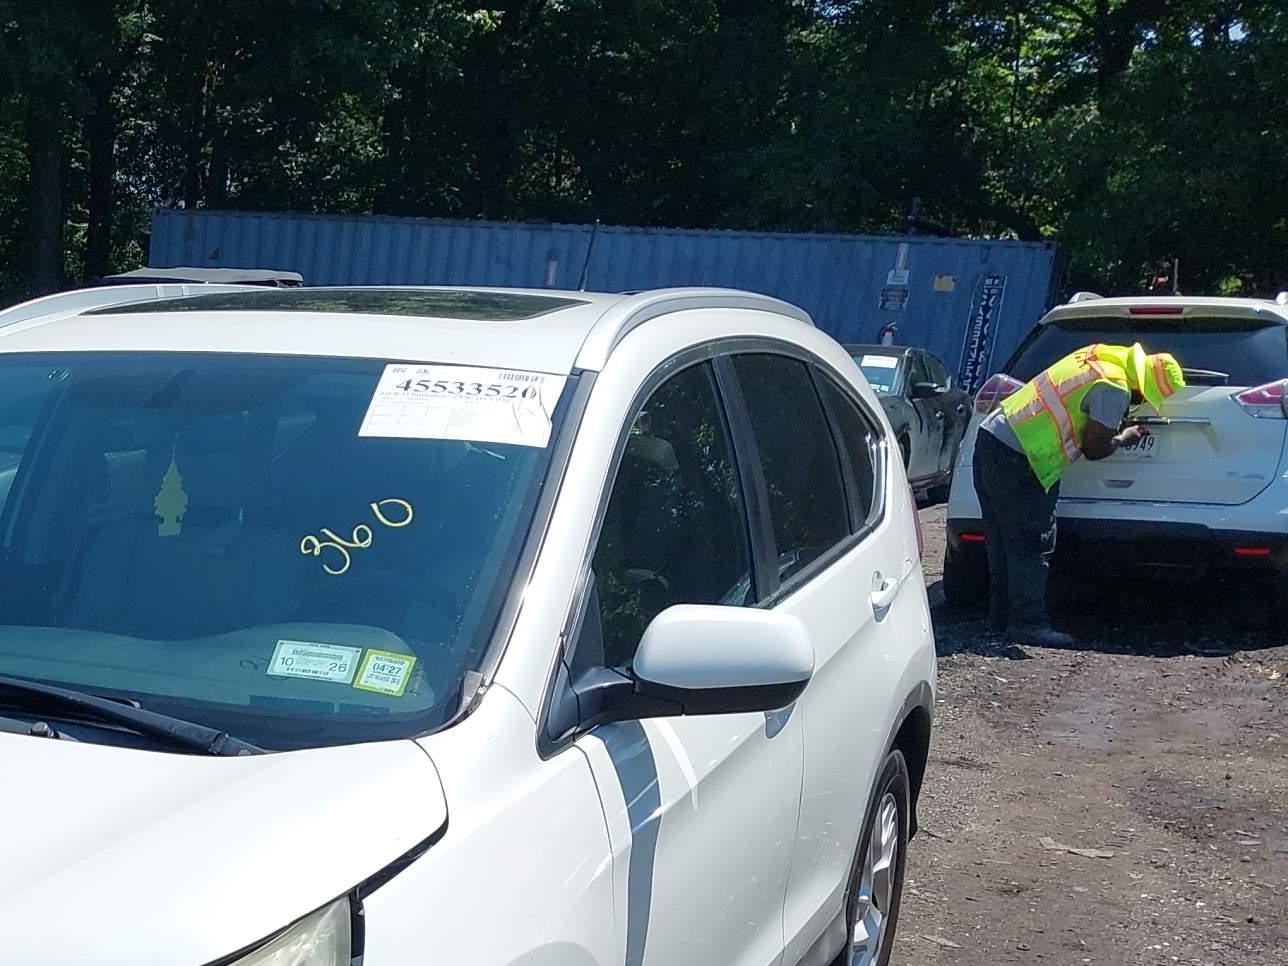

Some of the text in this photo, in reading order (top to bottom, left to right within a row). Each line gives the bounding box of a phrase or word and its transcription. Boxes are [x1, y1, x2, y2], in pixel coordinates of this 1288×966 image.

[395, 378, 538, 400] 45533520
[300, 498, 413, 575] 360
[280, 656, 294, 666] 10
[329, 662, 347, 673] 26
